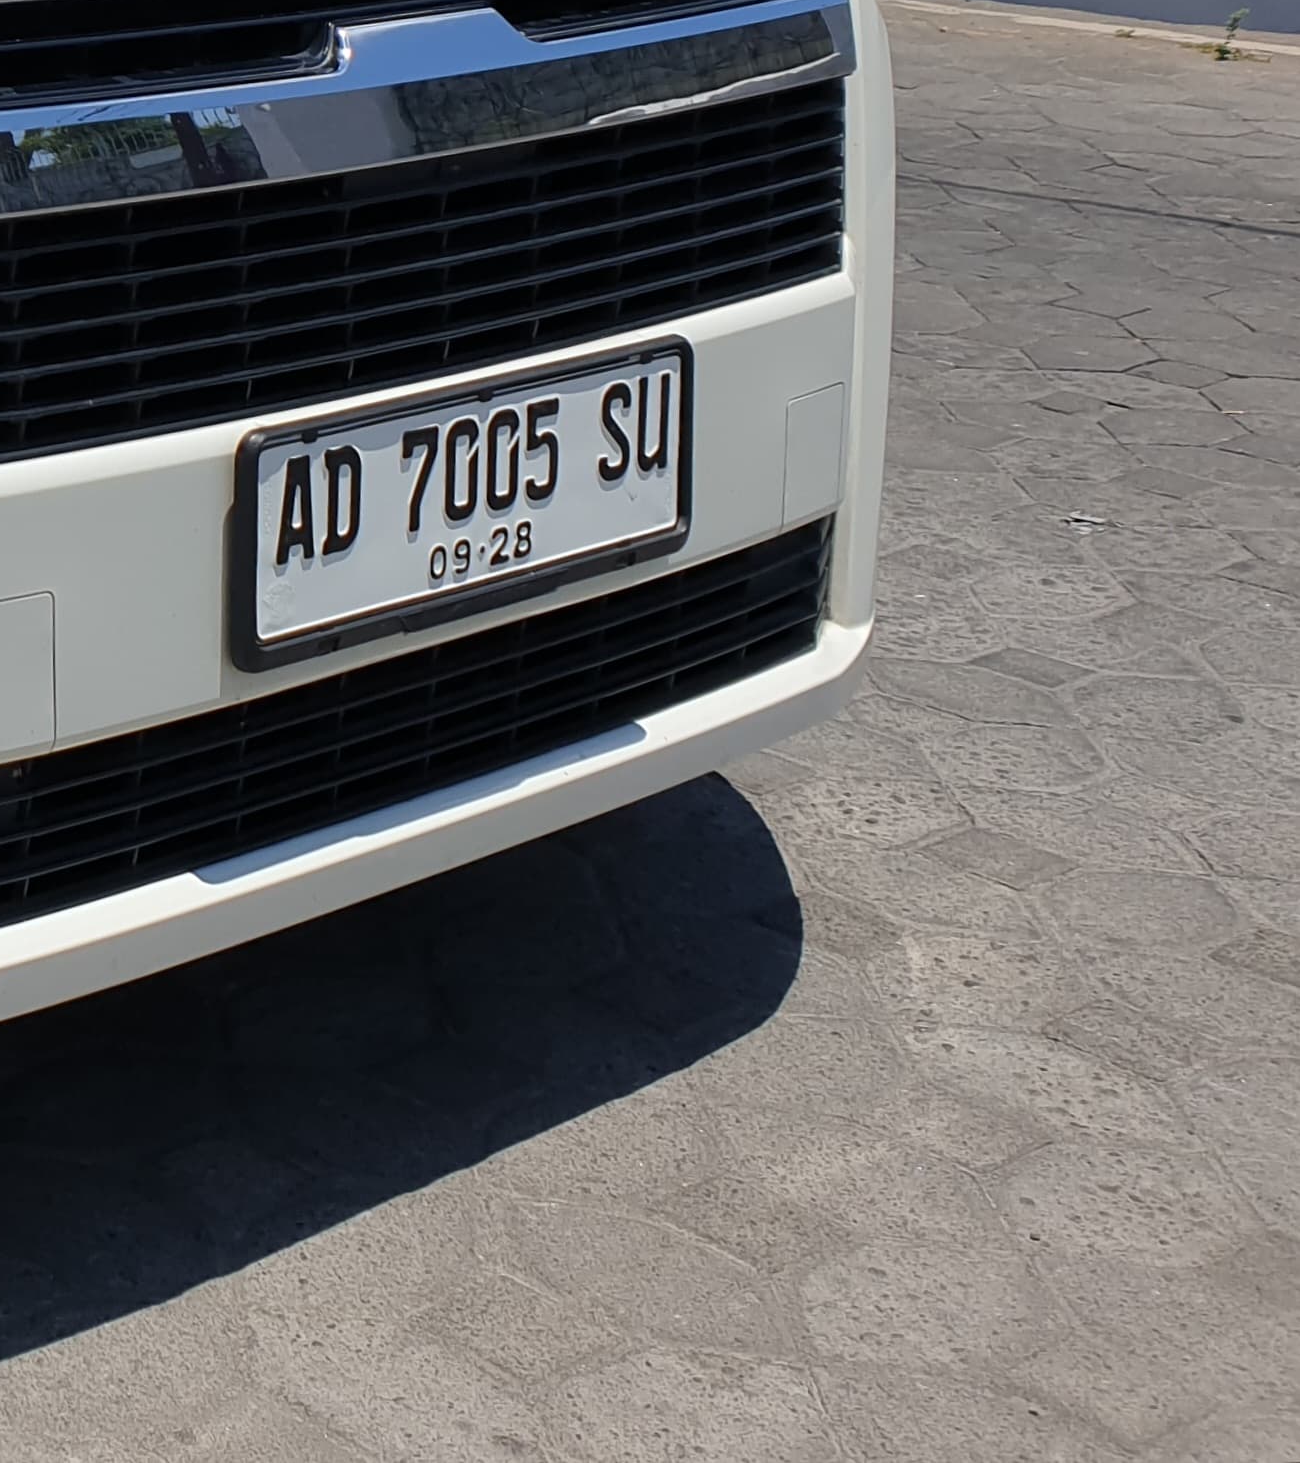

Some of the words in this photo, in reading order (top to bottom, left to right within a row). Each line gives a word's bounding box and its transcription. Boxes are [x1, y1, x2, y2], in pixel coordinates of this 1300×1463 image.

[274, 444, 362, 566] AD
[401, 398, 560, 533] 7005
[598, 372, 672, 481] SU
